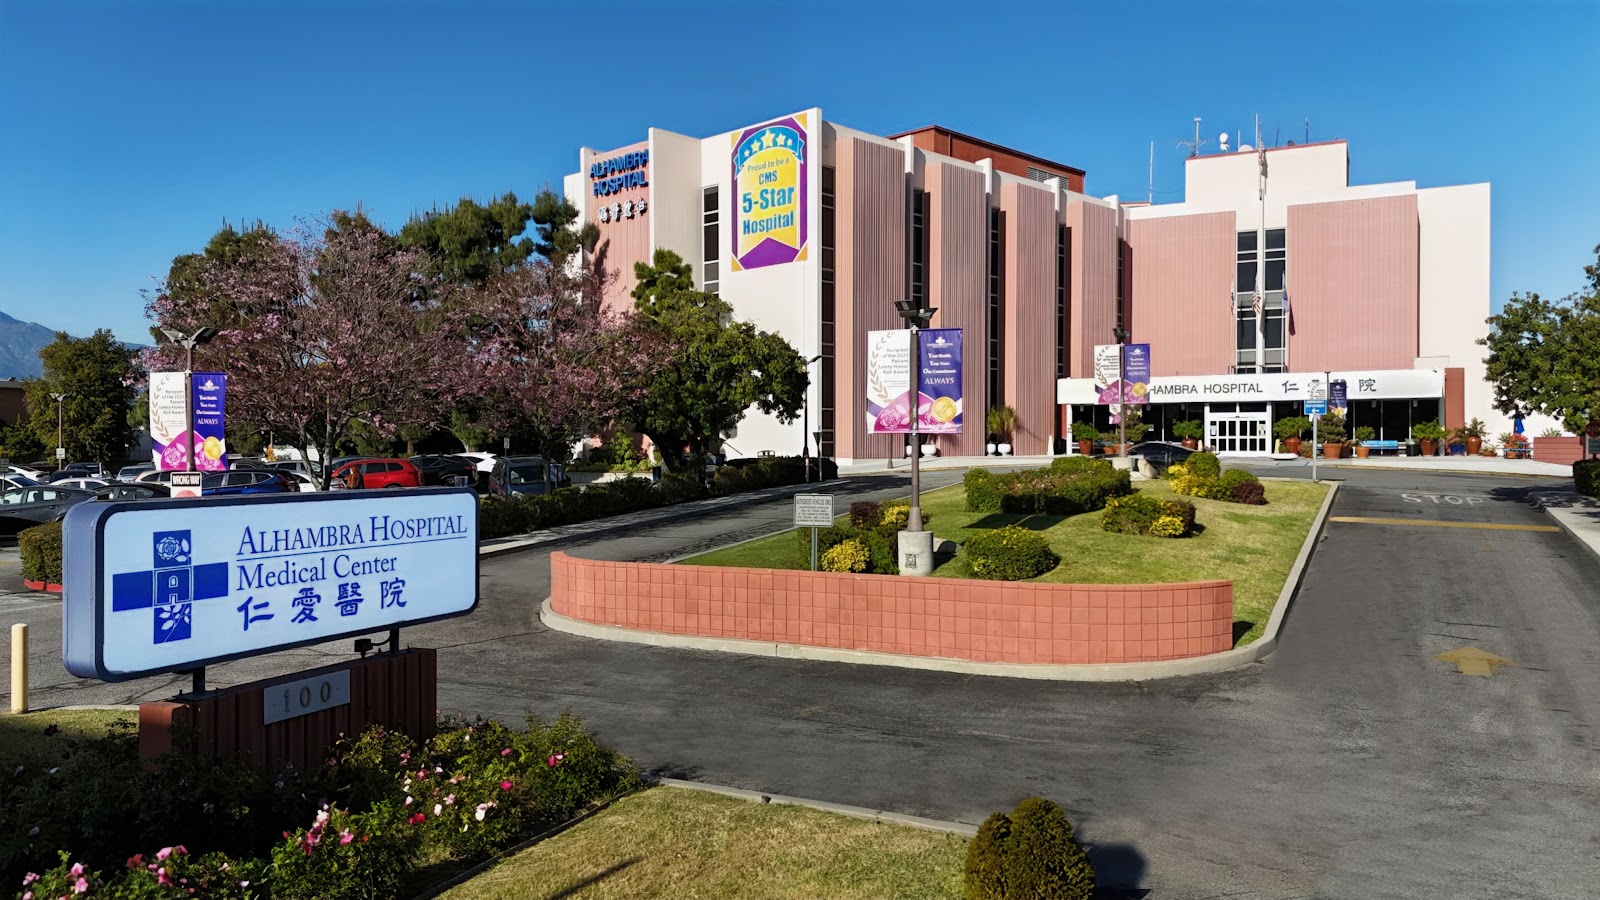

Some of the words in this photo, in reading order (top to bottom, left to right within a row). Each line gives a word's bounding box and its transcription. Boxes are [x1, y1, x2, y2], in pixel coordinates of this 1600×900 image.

[590, 149, 649, 177] ALHAMBRA
[747, 162, 767, 173] Proud
[775, 158, 785, 166] be
[592, 171, 647, 197] HOSPITAL
[758, 170, 778, 185] CMS
[742, 186, 795, 213] 5-Star
[742, 210, 794, 235] Hospital
[924, 377, 955, 385] ALWAYS
[1150, 385, 1198, 395] HAMBRA
[1203, 383, 1263, 394] HOSPITAL
[172, 475, 189, 485] WRONG
[190, 475, 201, 485] WAY
[1400, 493, 1484, 506] STOP
[236, 523, 365, 556] ALHAMBRA
[369, 514, 467, 542] HOSPITAL
[236, 557, 326, 591] Medical
[333, 554, 398, 578] Center
[237, 577, 408, 631] 仁愛醫院
[283, 681, 331, 713] 100
